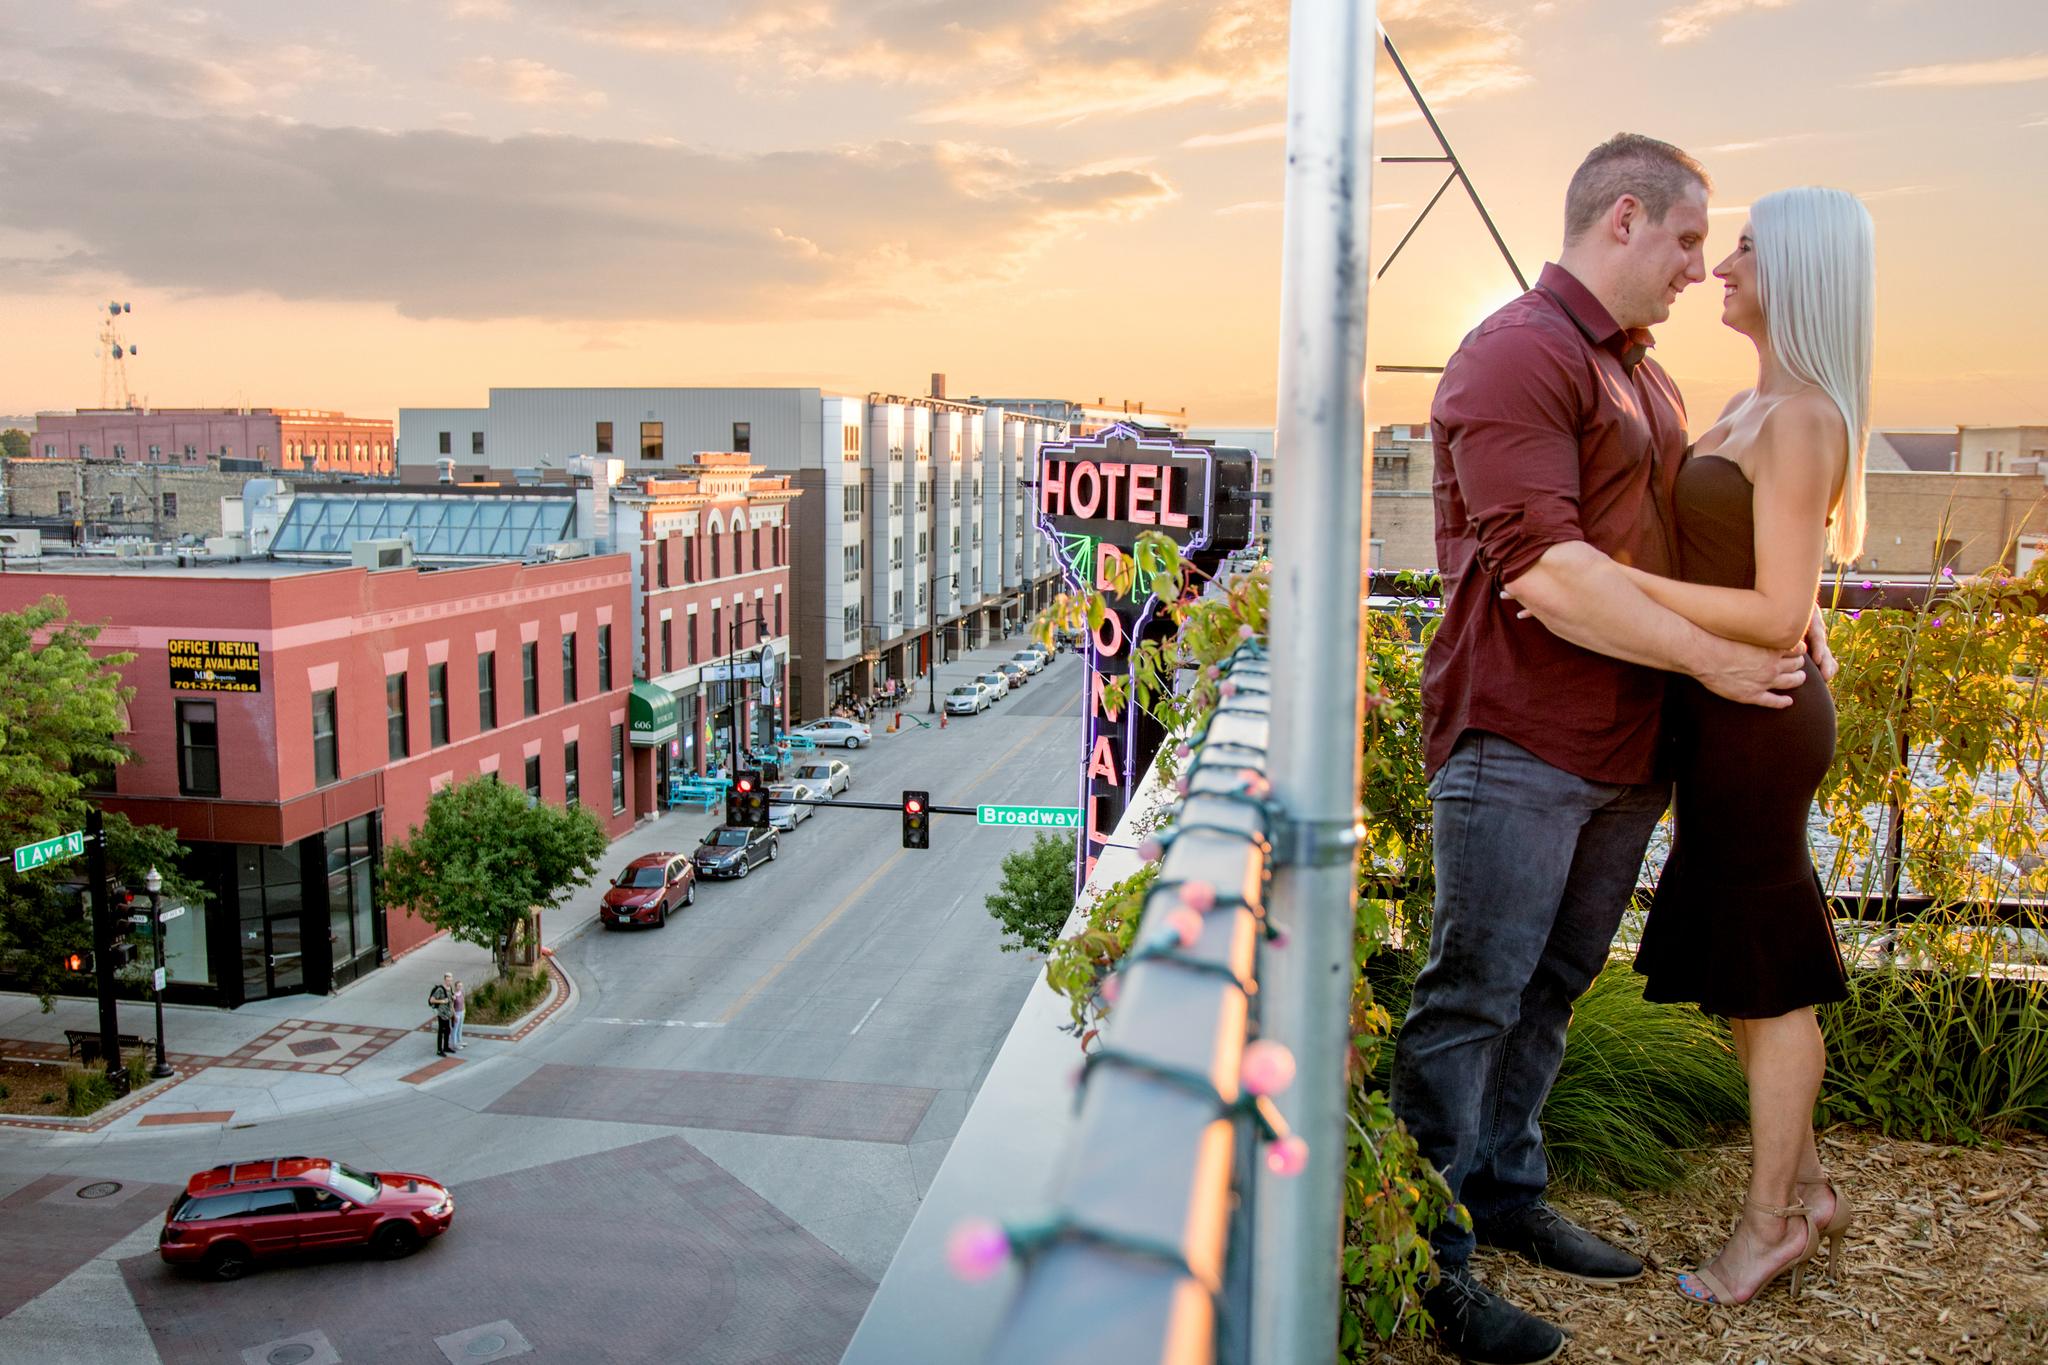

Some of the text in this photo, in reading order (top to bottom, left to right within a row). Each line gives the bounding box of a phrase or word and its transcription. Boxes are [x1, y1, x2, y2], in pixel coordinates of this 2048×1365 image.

[1041, 459, 1189, 528] HOTEL
[169, 640, 259, 656] OFFICE / RETAIL
[170, 655, 259, 671] SPACE AVAILABLE
[174, 681, 257, 692] 701-371-4484
[634, 721, 651, 729] 606
[983, 807, 1079, 828] Broadway
[32, 843, 63, 865] Ave
[68, 835, 80, 852] N
